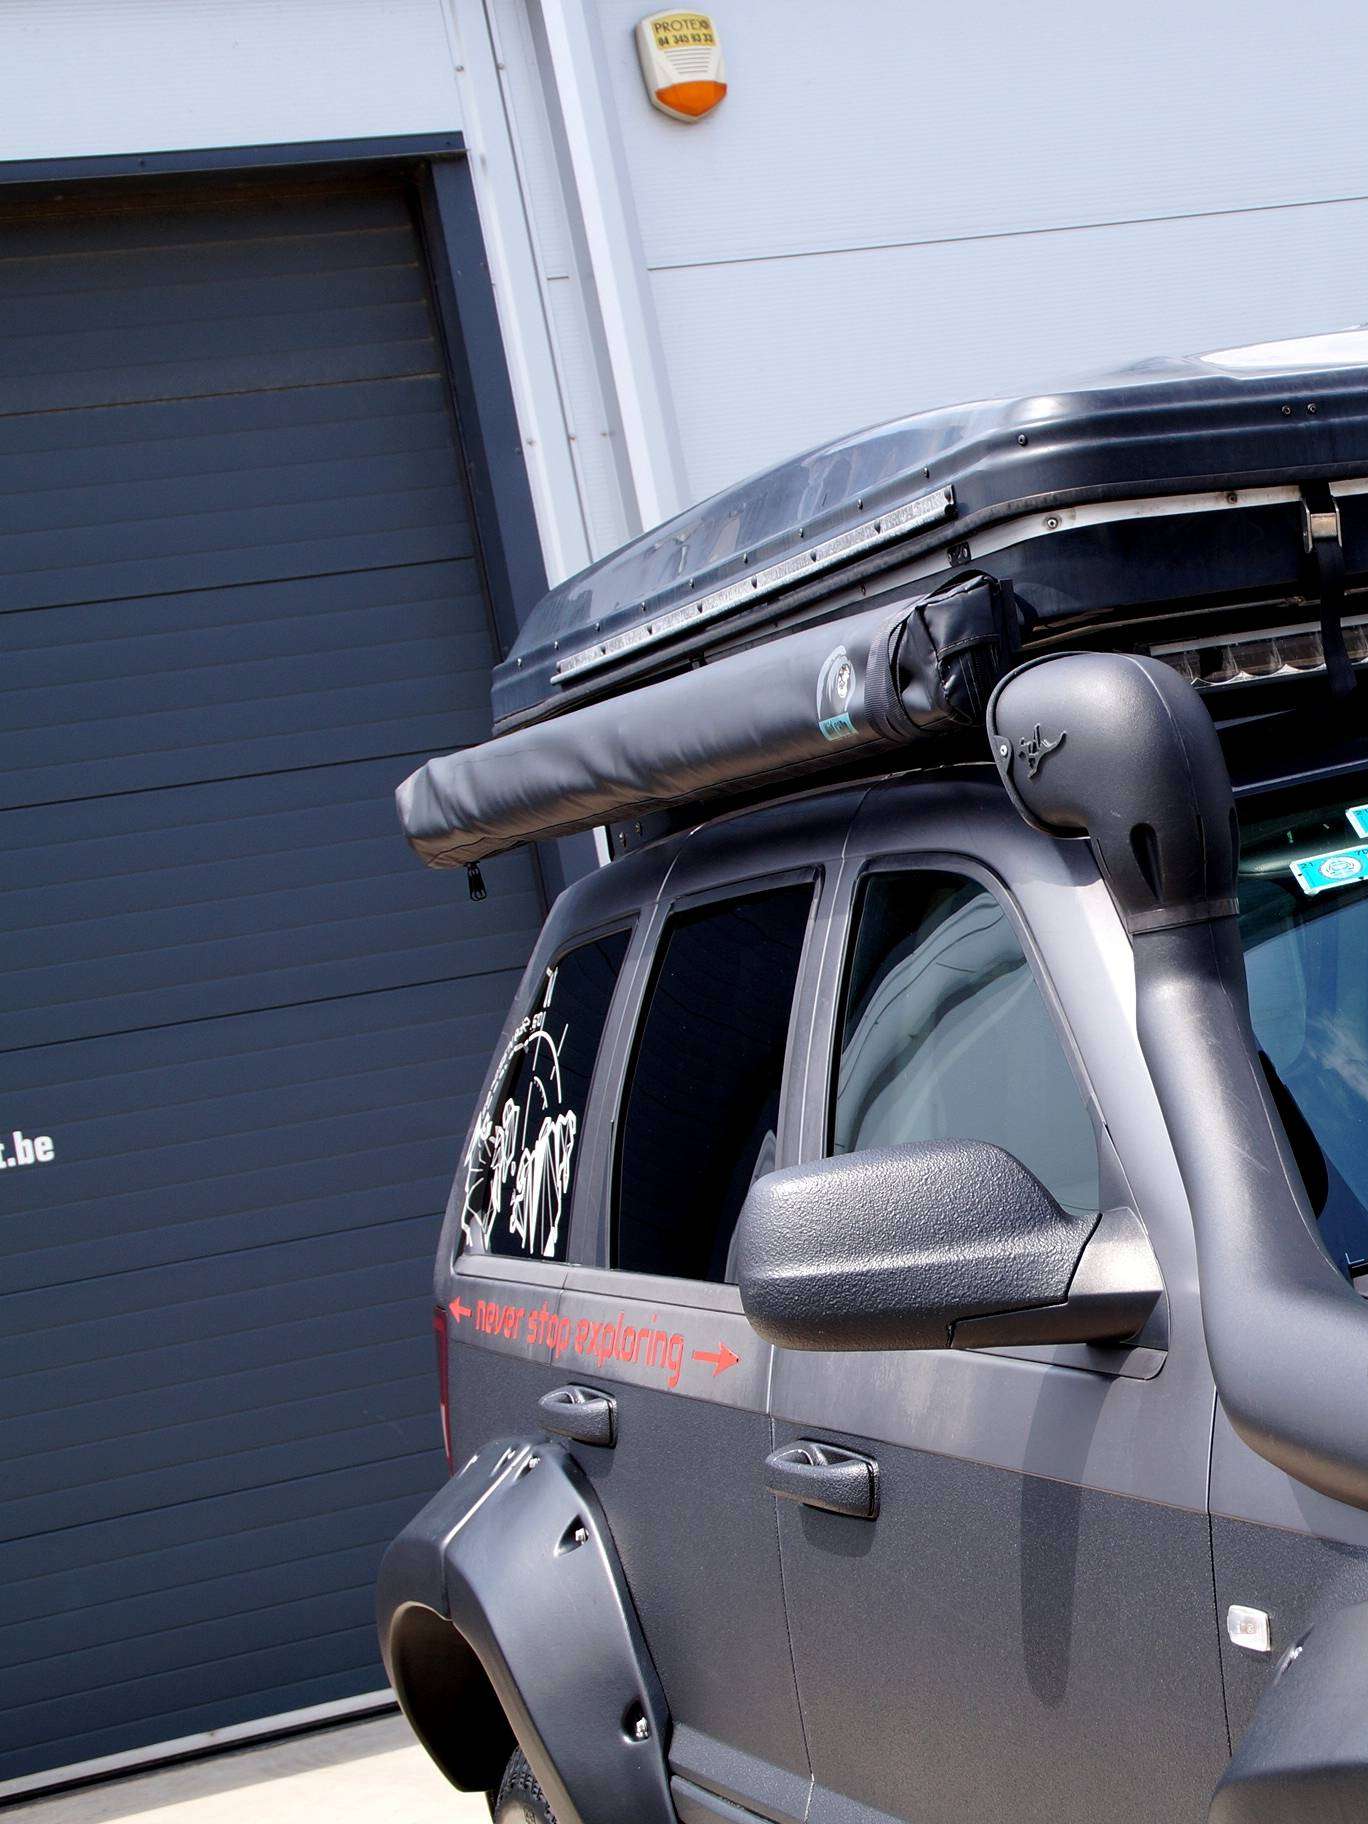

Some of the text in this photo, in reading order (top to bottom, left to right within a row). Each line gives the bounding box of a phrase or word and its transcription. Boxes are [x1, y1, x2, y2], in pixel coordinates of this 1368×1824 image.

[475, 1299, 684, 1389] never stop exploring
